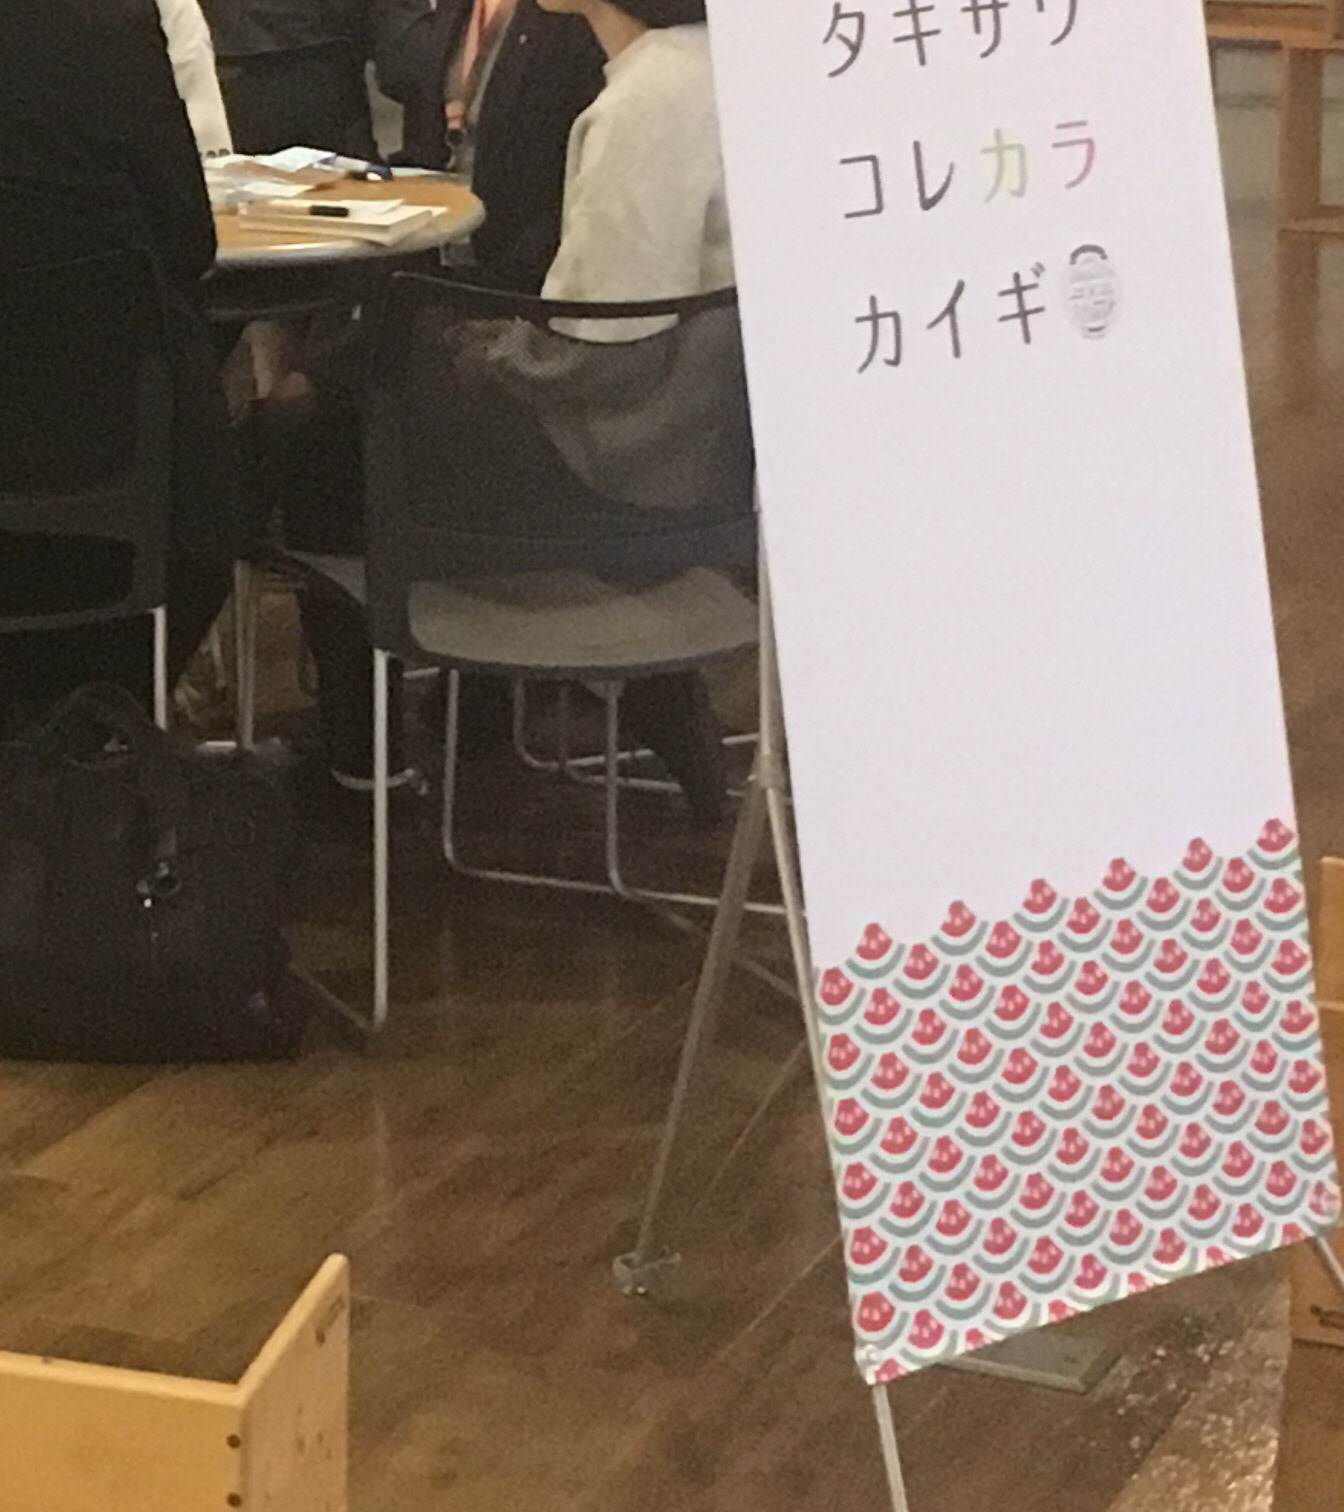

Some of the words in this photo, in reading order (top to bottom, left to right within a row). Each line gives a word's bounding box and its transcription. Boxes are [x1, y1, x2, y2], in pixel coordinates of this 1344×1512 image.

[839, 119, 1096, 220] コレカラ
[854, 262, 1046, 374] カイギ
